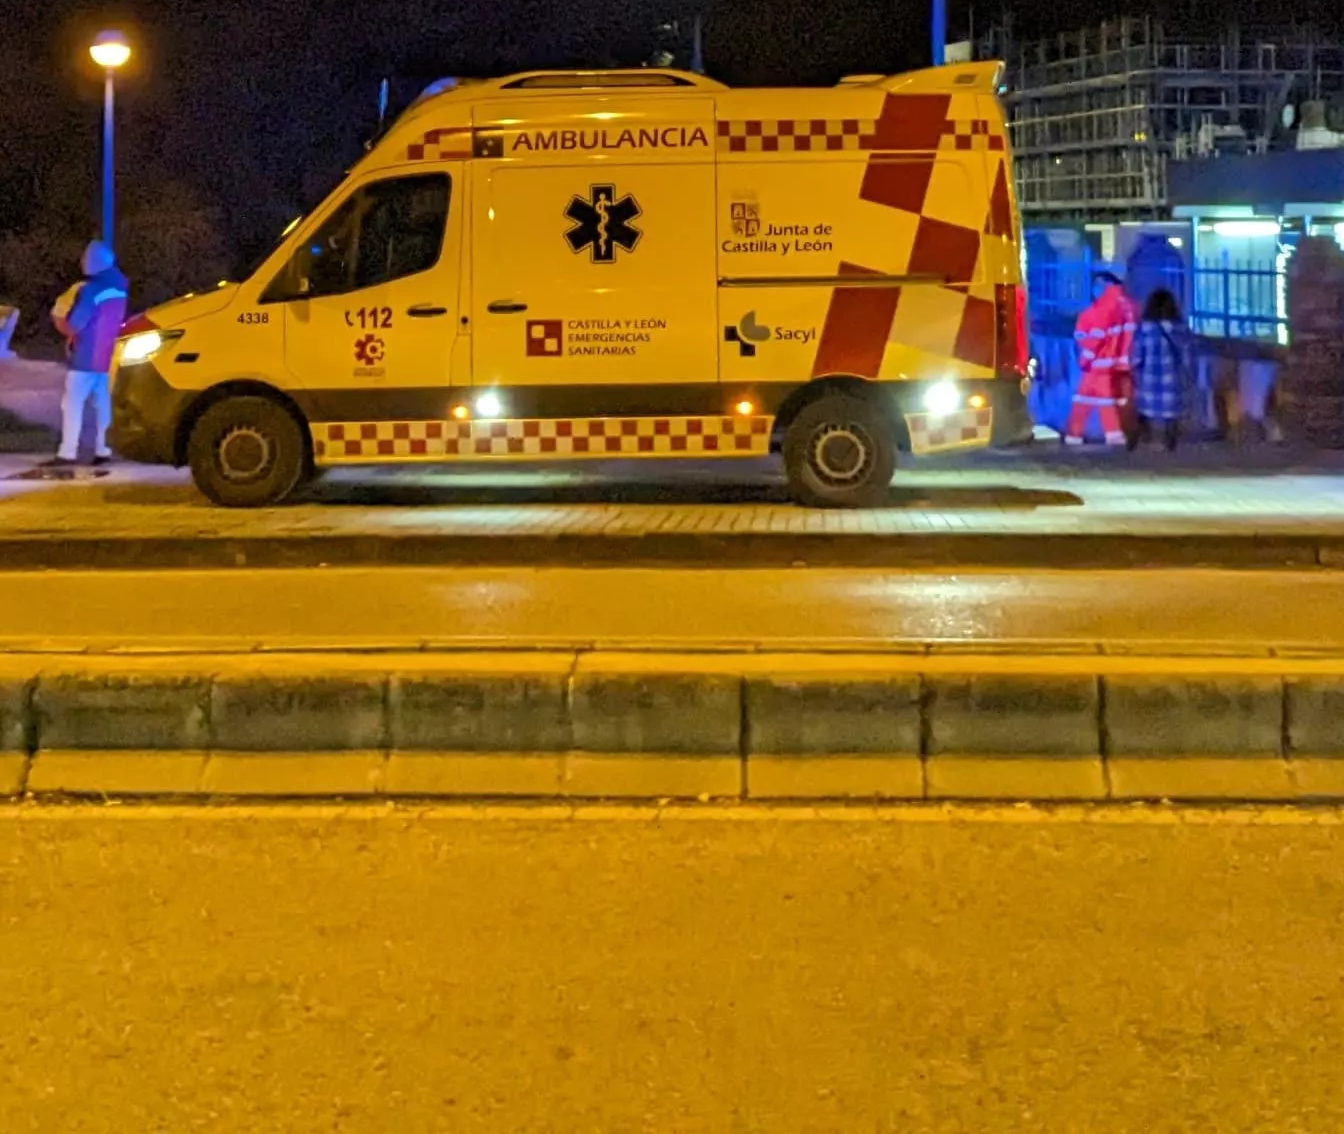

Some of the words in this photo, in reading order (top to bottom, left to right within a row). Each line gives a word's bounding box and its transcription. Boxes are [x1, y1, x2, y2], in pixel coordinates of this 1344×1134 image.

[511, 126, 710, 152] AMBULANCIA
[764, 223, 809, 237] Junta
[812, 222, 833, 236] de
[721, 239, 778, 253] Castilla
[780, 241, 791, 256] y
[794, 238, 833, 252] León
[236, 312, 270, 325] 4338
[356, 306, 394, 330] 112
[567, 319, 622, 330] CASTILLA
[624, 319, 633, 329] Y
[635, 317, 667, 329] LEÓN
[567, 332, 651, 343] EMERGENCIAS
[774, 326, 816, 344] Sacyl
[567, 345, 637, 356] SANITARIAS
